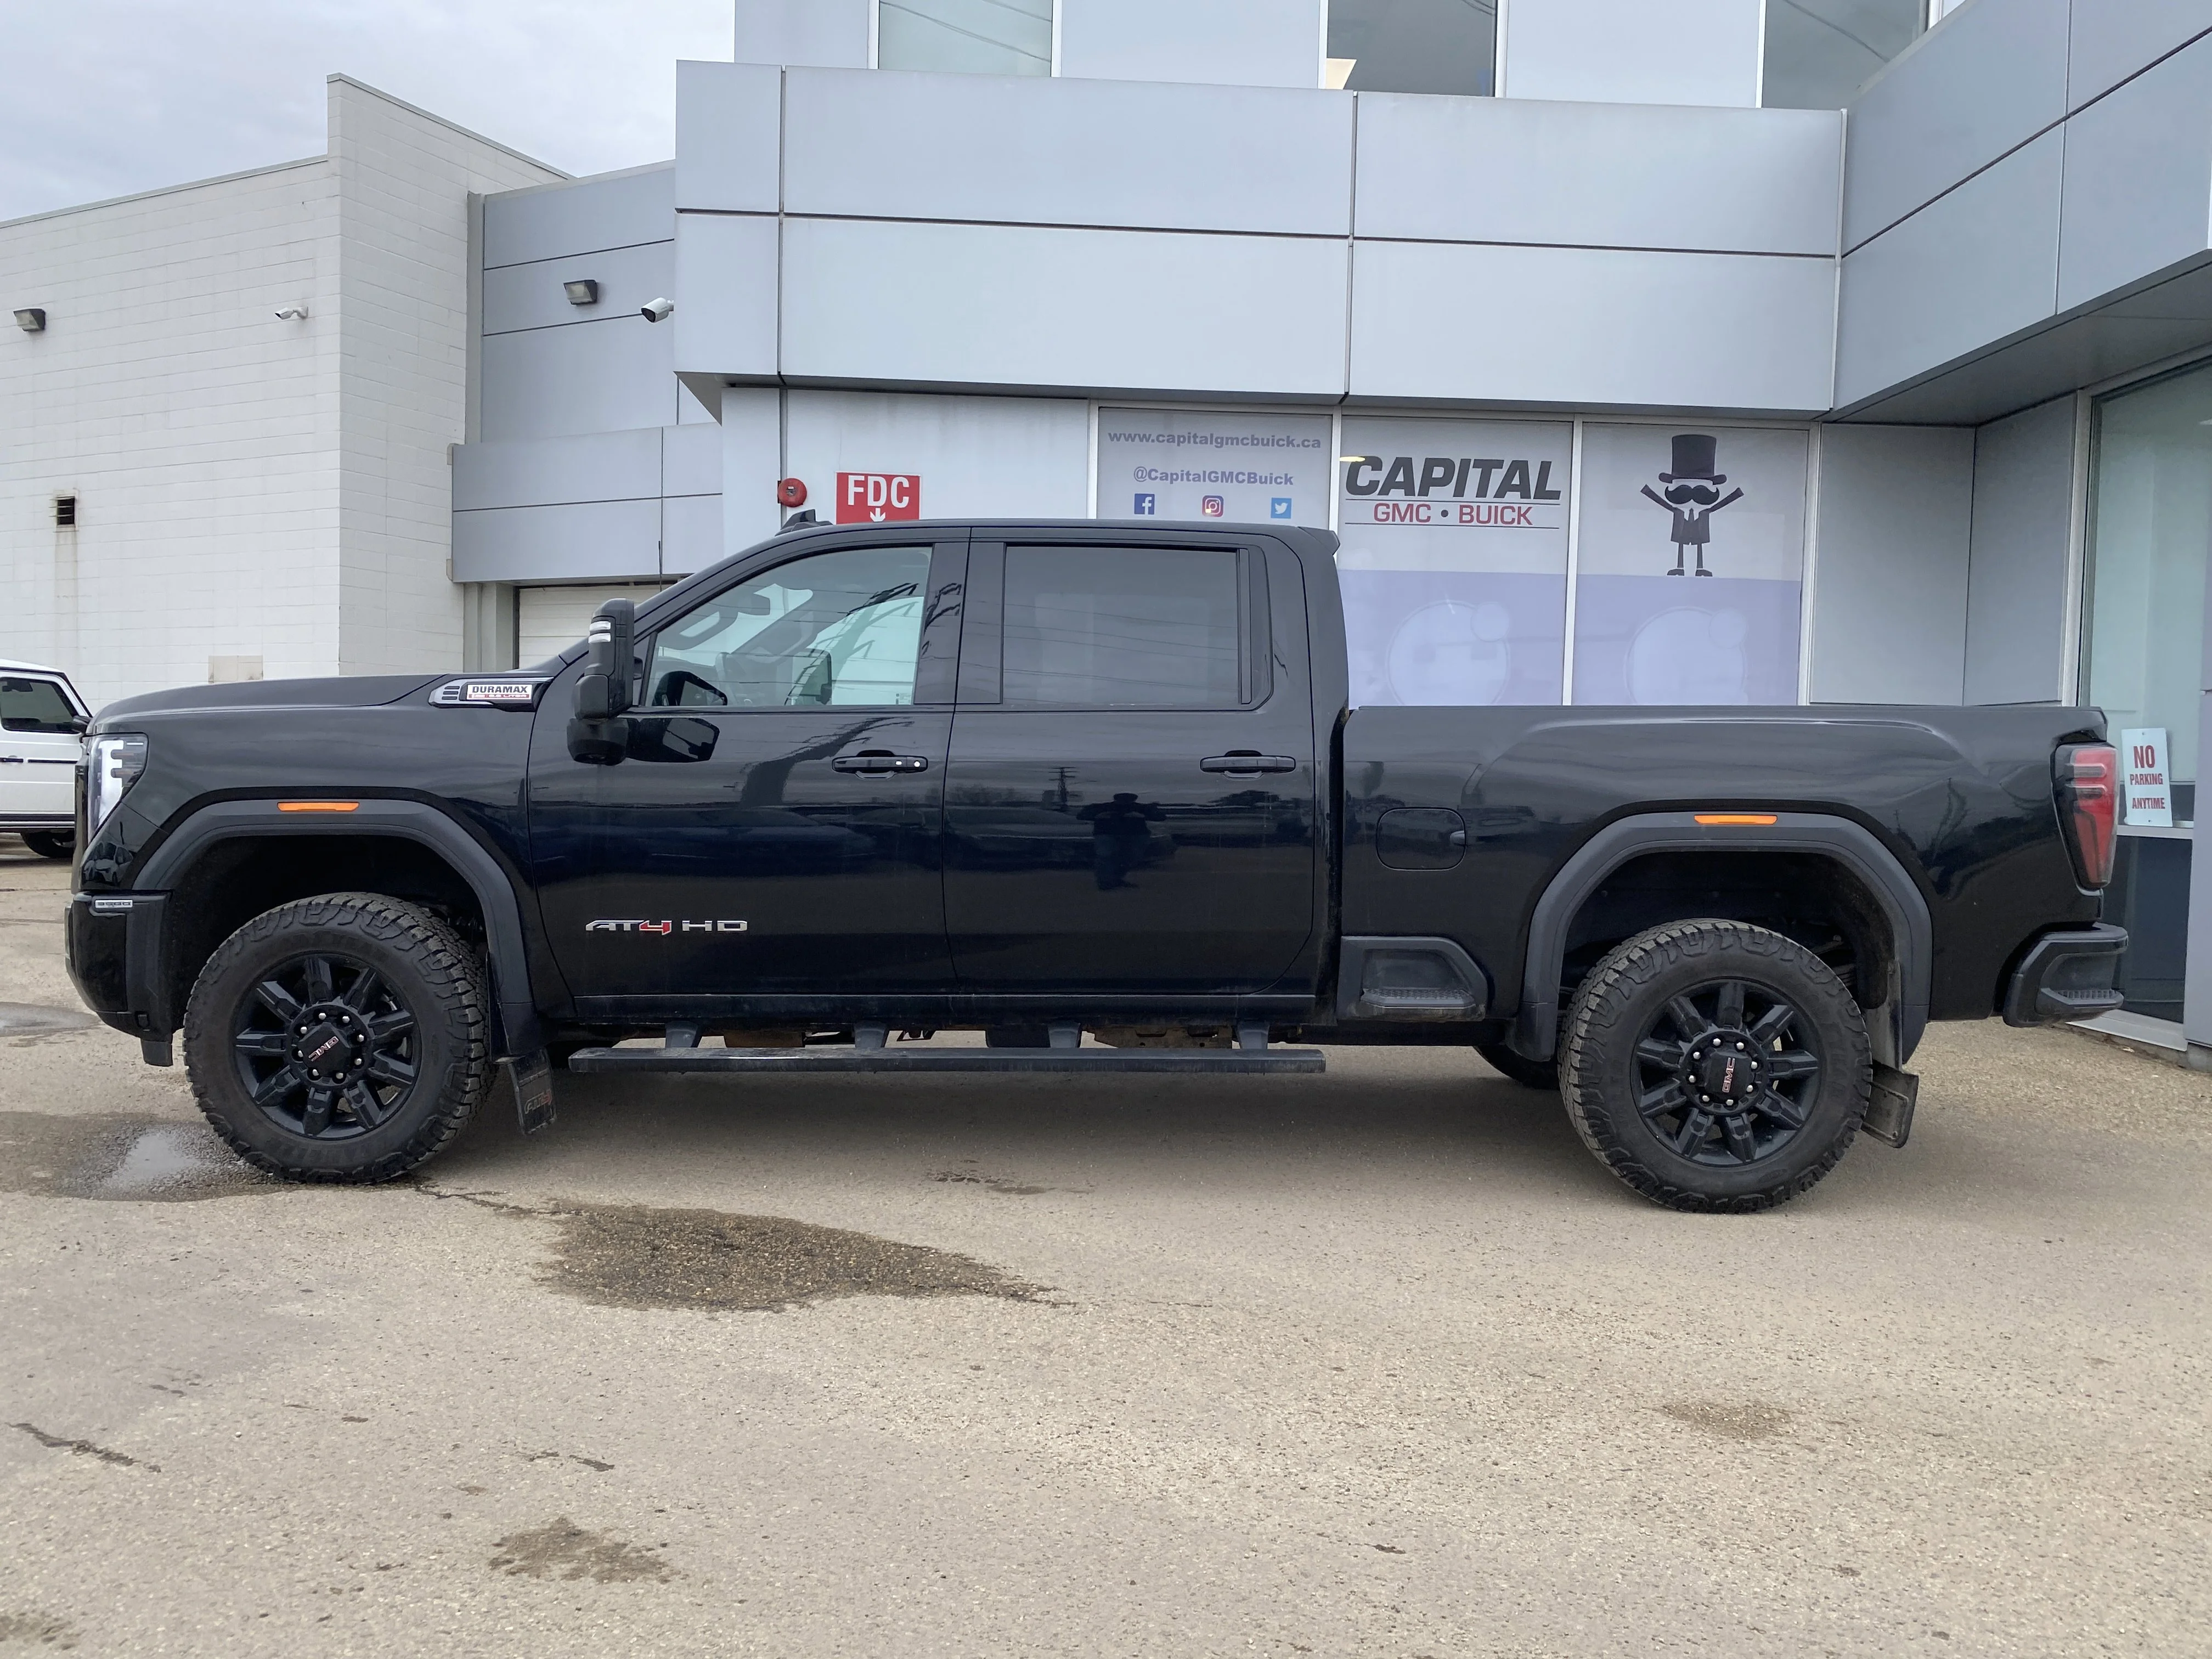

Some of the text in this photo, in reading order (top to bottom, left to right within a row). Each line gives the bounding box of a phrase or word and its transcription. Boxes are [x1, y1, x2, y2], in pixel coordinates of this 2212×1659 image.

[1108, 432, 1321, 449] www.capitalgmcbuick.ca
[1133, 466, 1294, 486] @CapitalGMCBuick
[1345, 455, 1561, 500] CAPITAL
[848, 475, 909, 509] FDC
[1374, 503, 1533, 525] GMC BUICK
[2133, 745, 2155, 768] NO
[2130, 773, 2163, 785] PARKING
[2132, 798, 2165, 809] ANYTIME
[585, 919, 747, 935] AT4 HD
[308, 1036, 340, 1062] GMC
[1722, 1057, 1736, 1093] GMC
